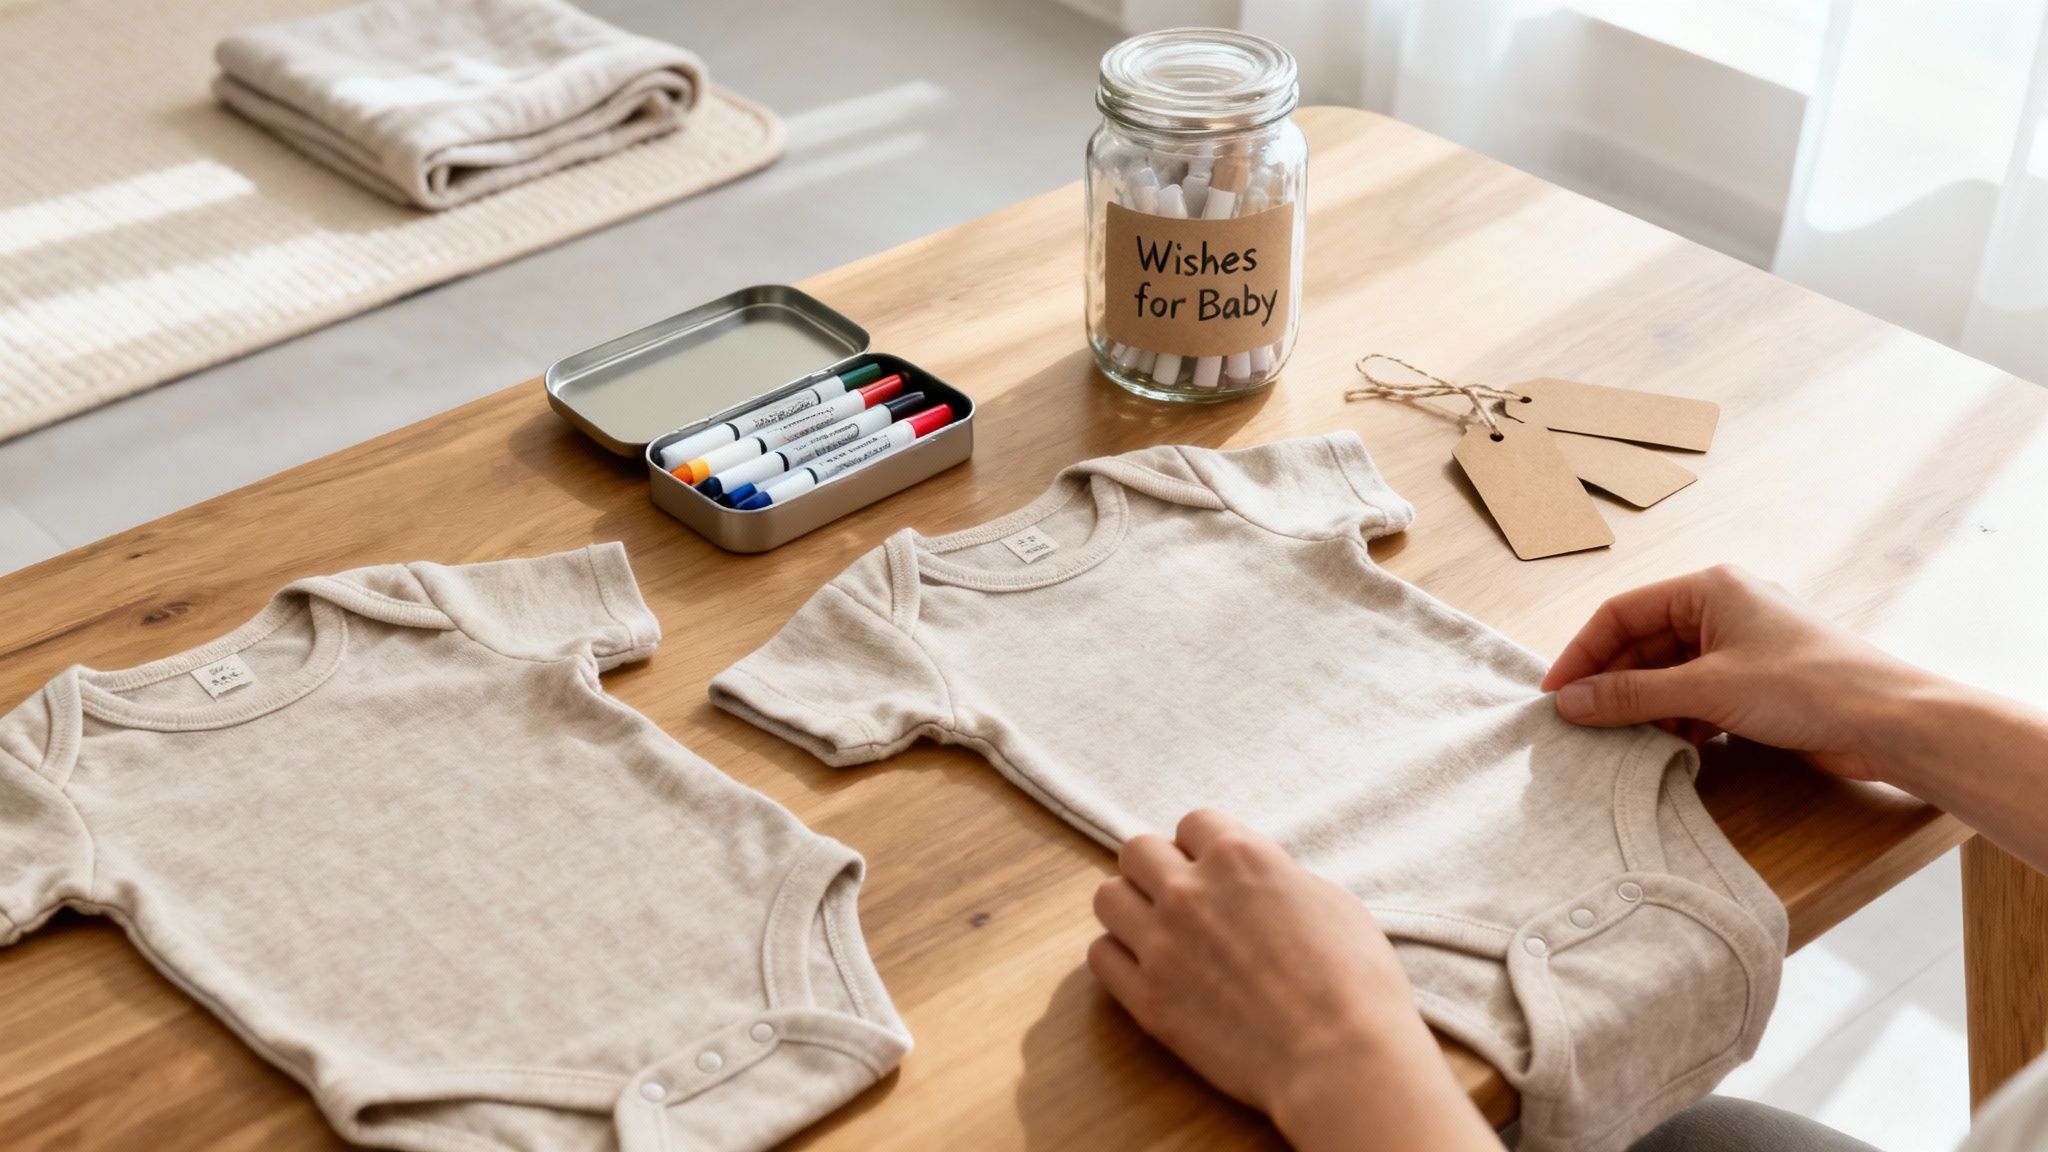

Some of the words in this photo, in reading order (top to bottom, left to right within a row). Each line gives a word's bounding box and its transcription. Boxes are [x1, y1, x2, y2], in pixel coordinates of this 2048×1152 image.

[1136, 235, 1257, 276] Wishes
[1134, 282, 1187, 319] for
[1198, 284, 1278, 327] Baby
